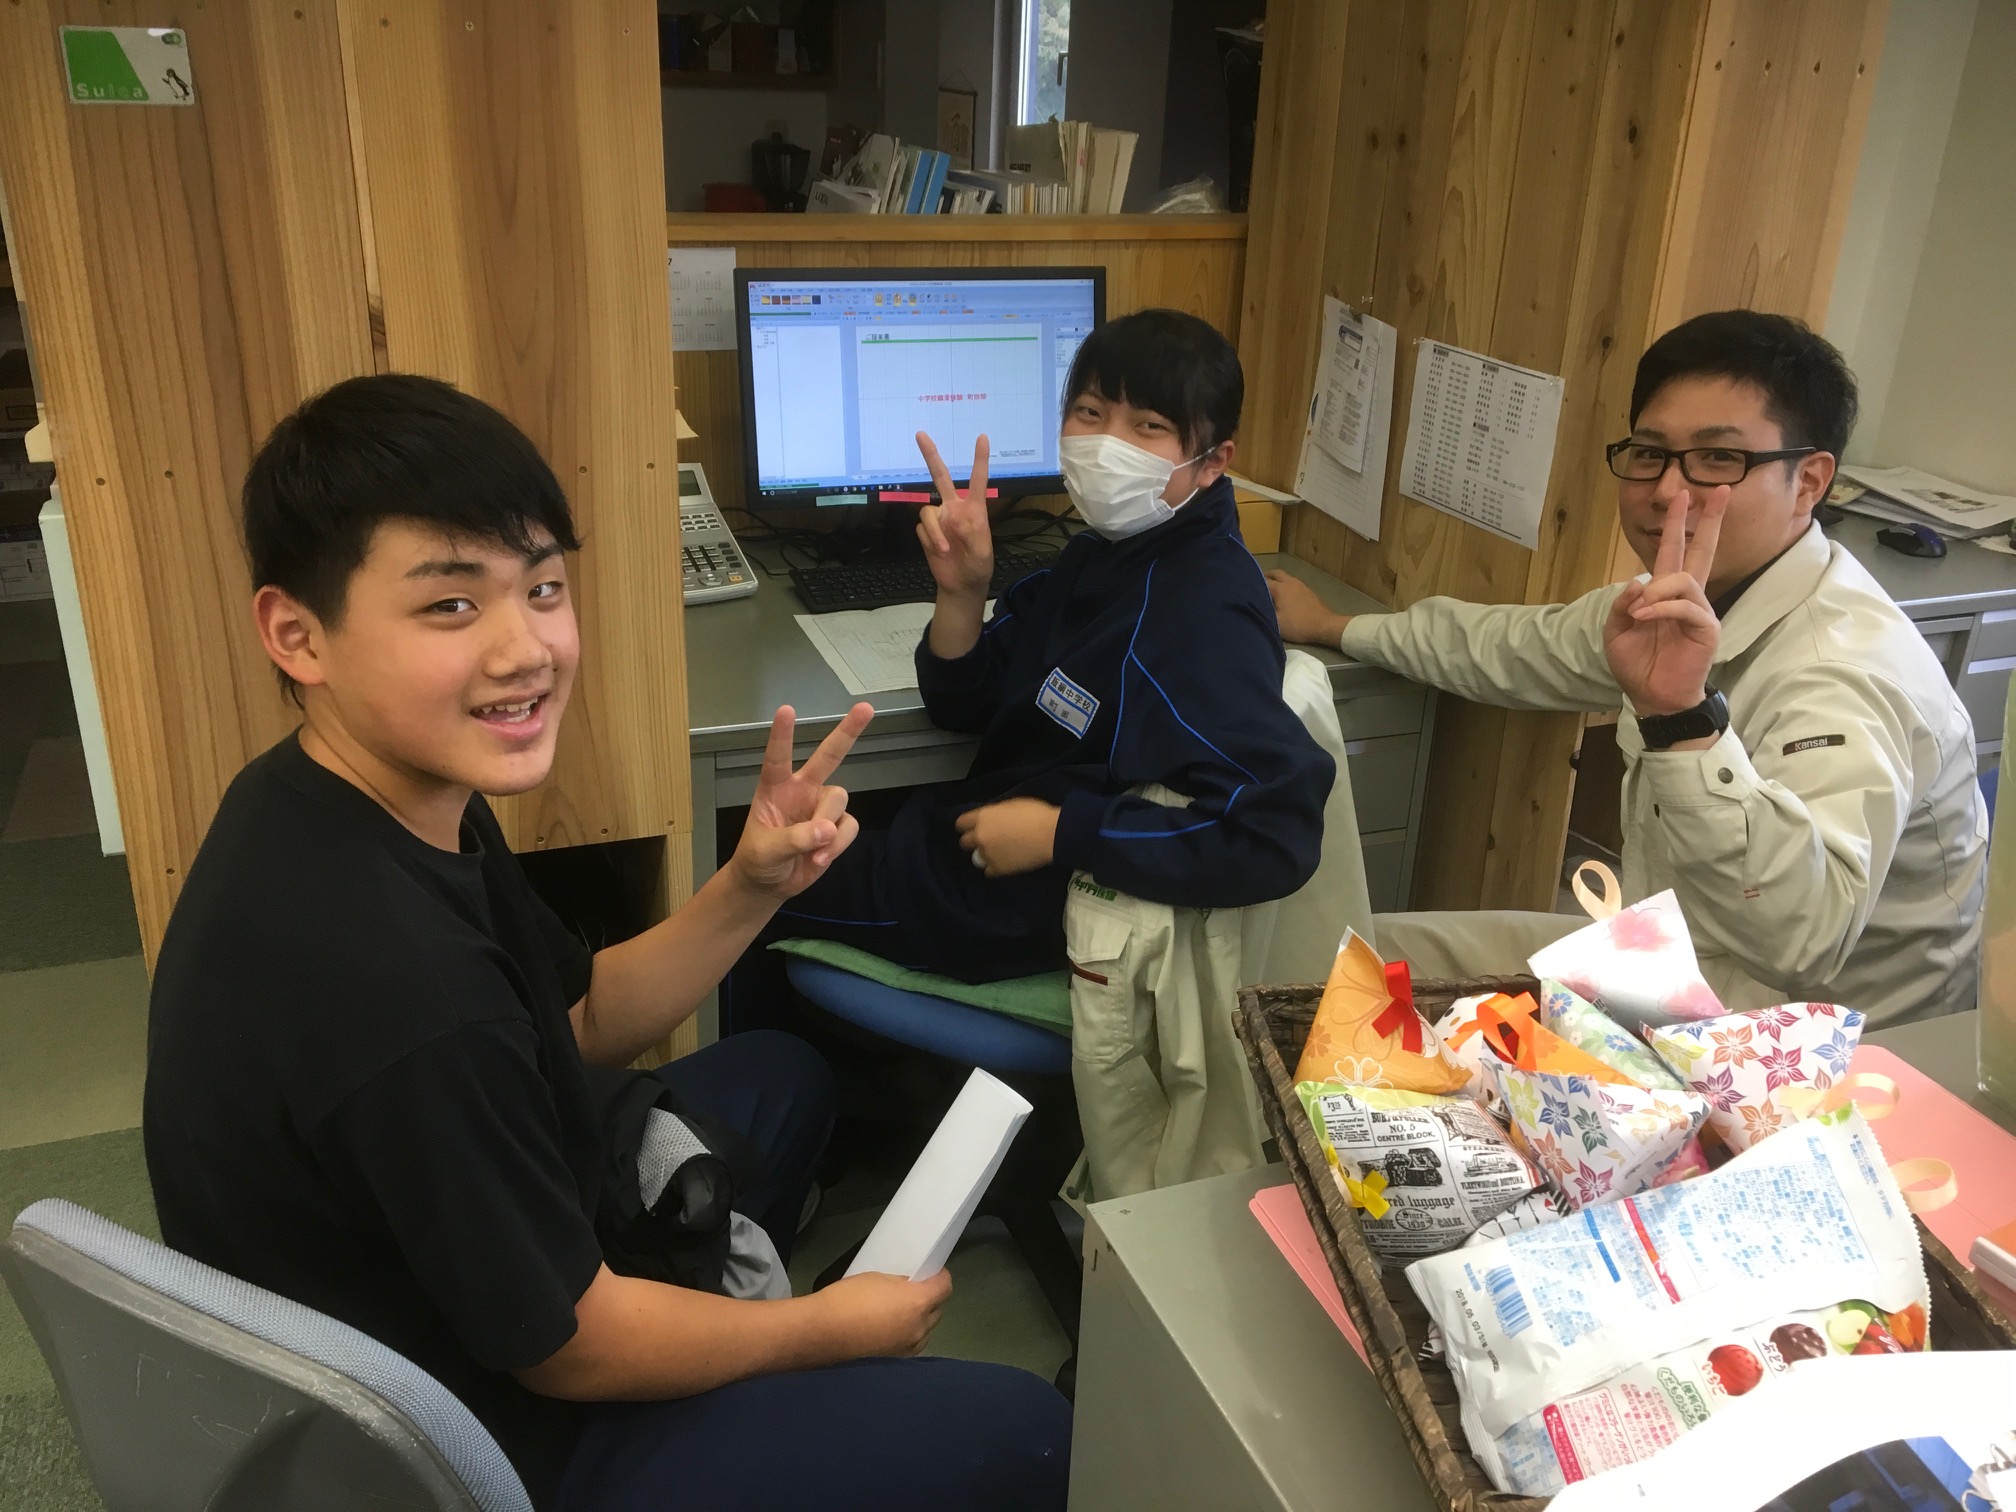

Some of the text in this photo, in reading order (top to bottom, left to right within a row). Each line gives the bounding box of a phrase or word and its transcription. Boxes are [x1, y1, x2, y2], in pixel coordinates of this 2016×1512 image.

[76, 82, 143, 98] Suica
[1377, 1133, 1405, 1142] CENTRE
[1407, 1195, 1455, 1209] luggage
[1763, 1342, 1786, 1372] ぶどう
[1702, 1362, 1726, 1395] いちご
